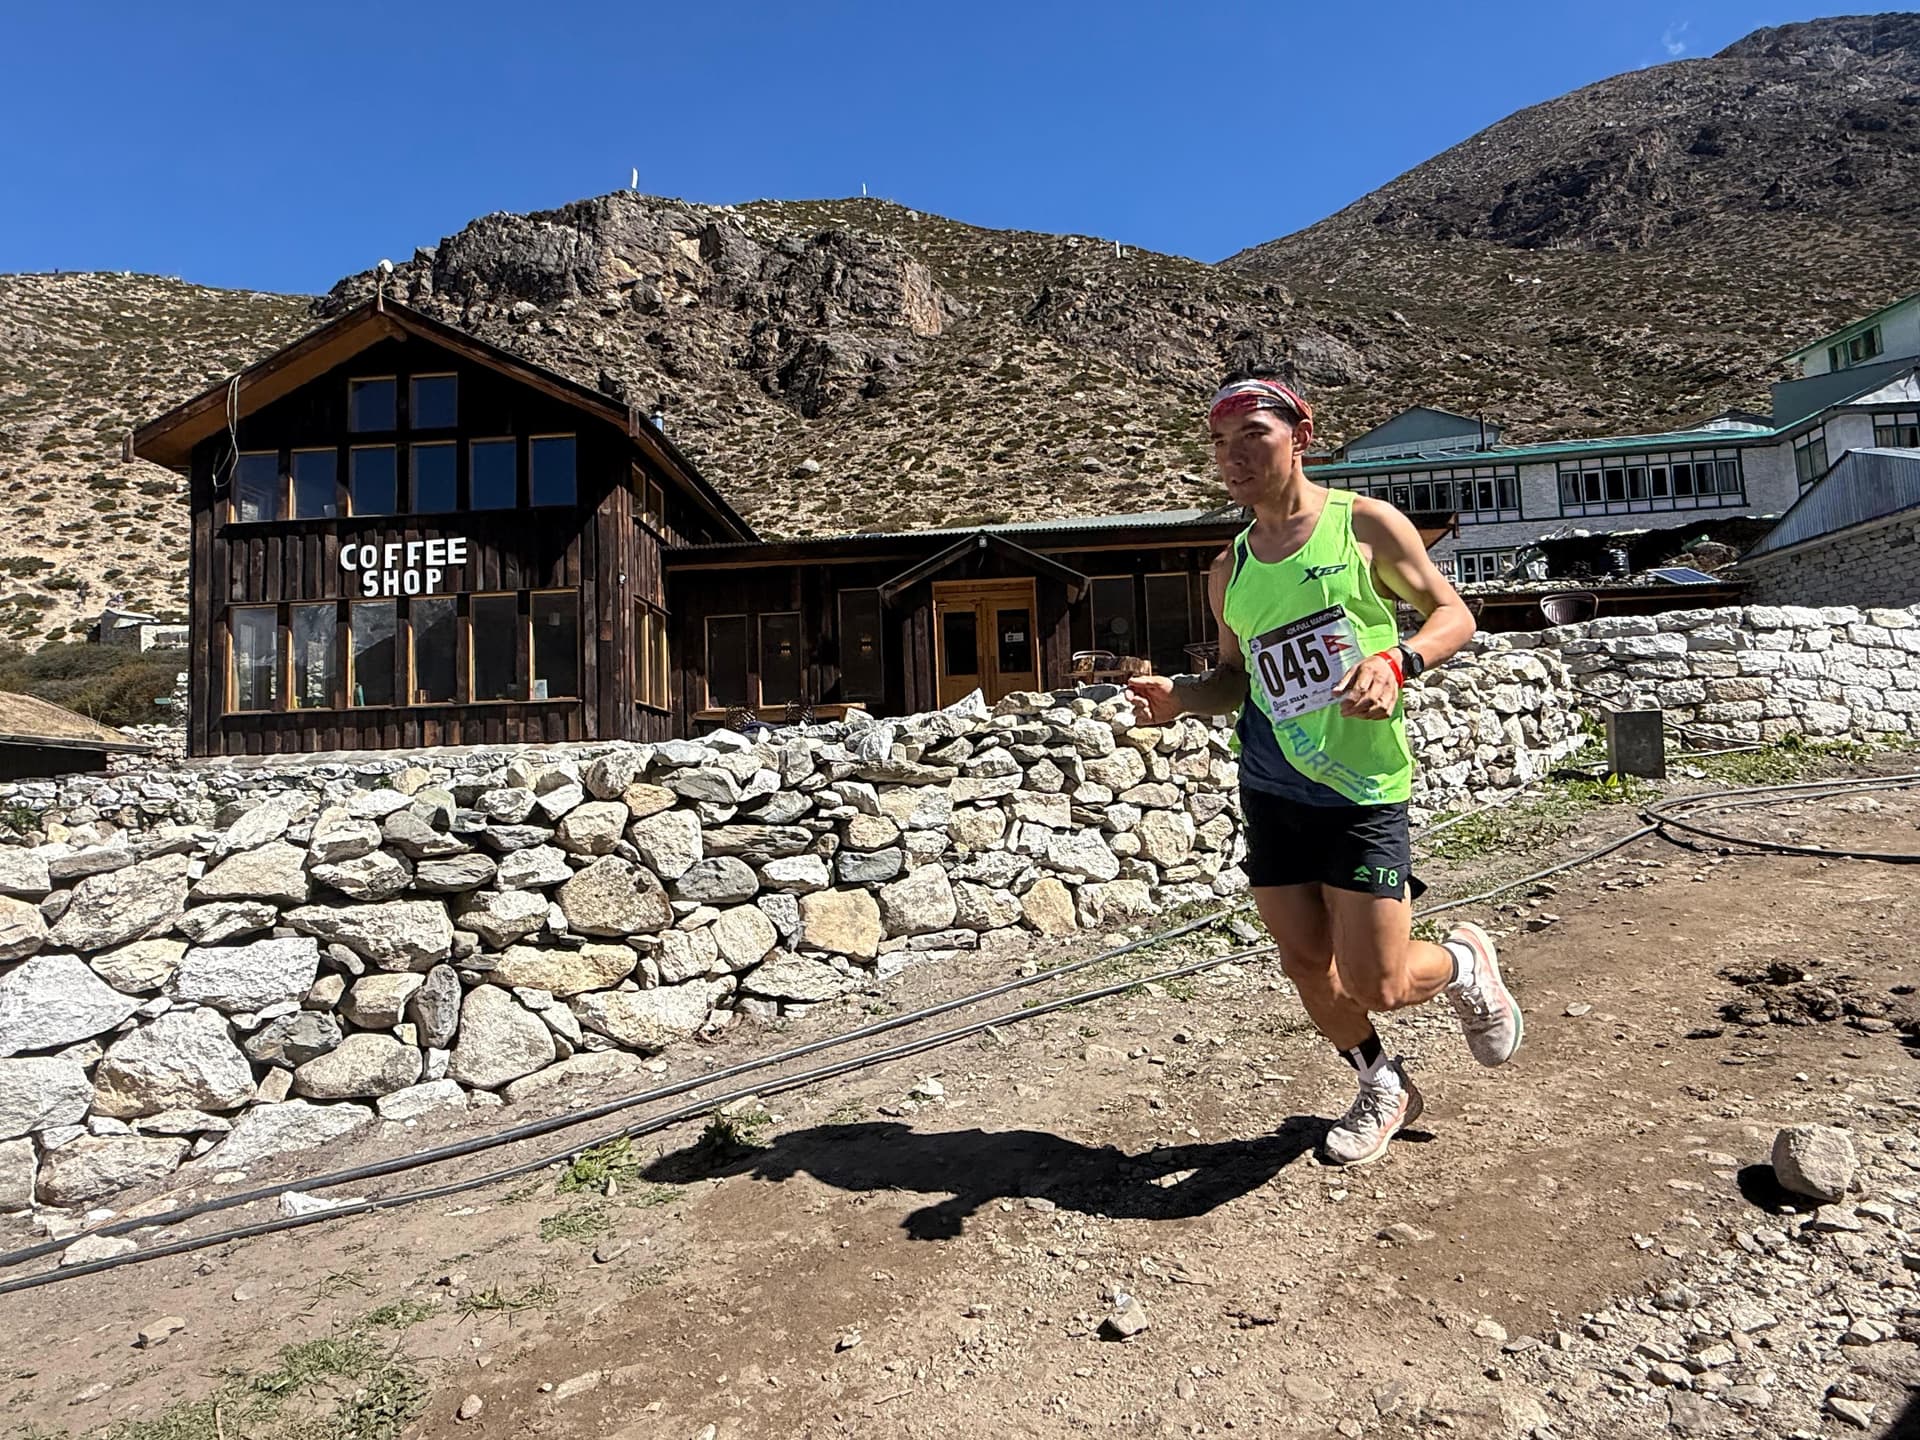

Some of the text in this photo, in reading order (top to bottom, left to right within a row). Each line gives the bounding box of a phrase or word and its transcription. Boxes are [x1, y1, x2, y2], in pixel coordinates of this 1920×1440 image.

[340, 537, 467, 571] COFFEE
[363, 568, 442, 597] SHOP
[1298, 564, 1348, 585] XTEP
[1258, 633, 1330, 697] 045
[1375, 866, 1399, 887] T8
